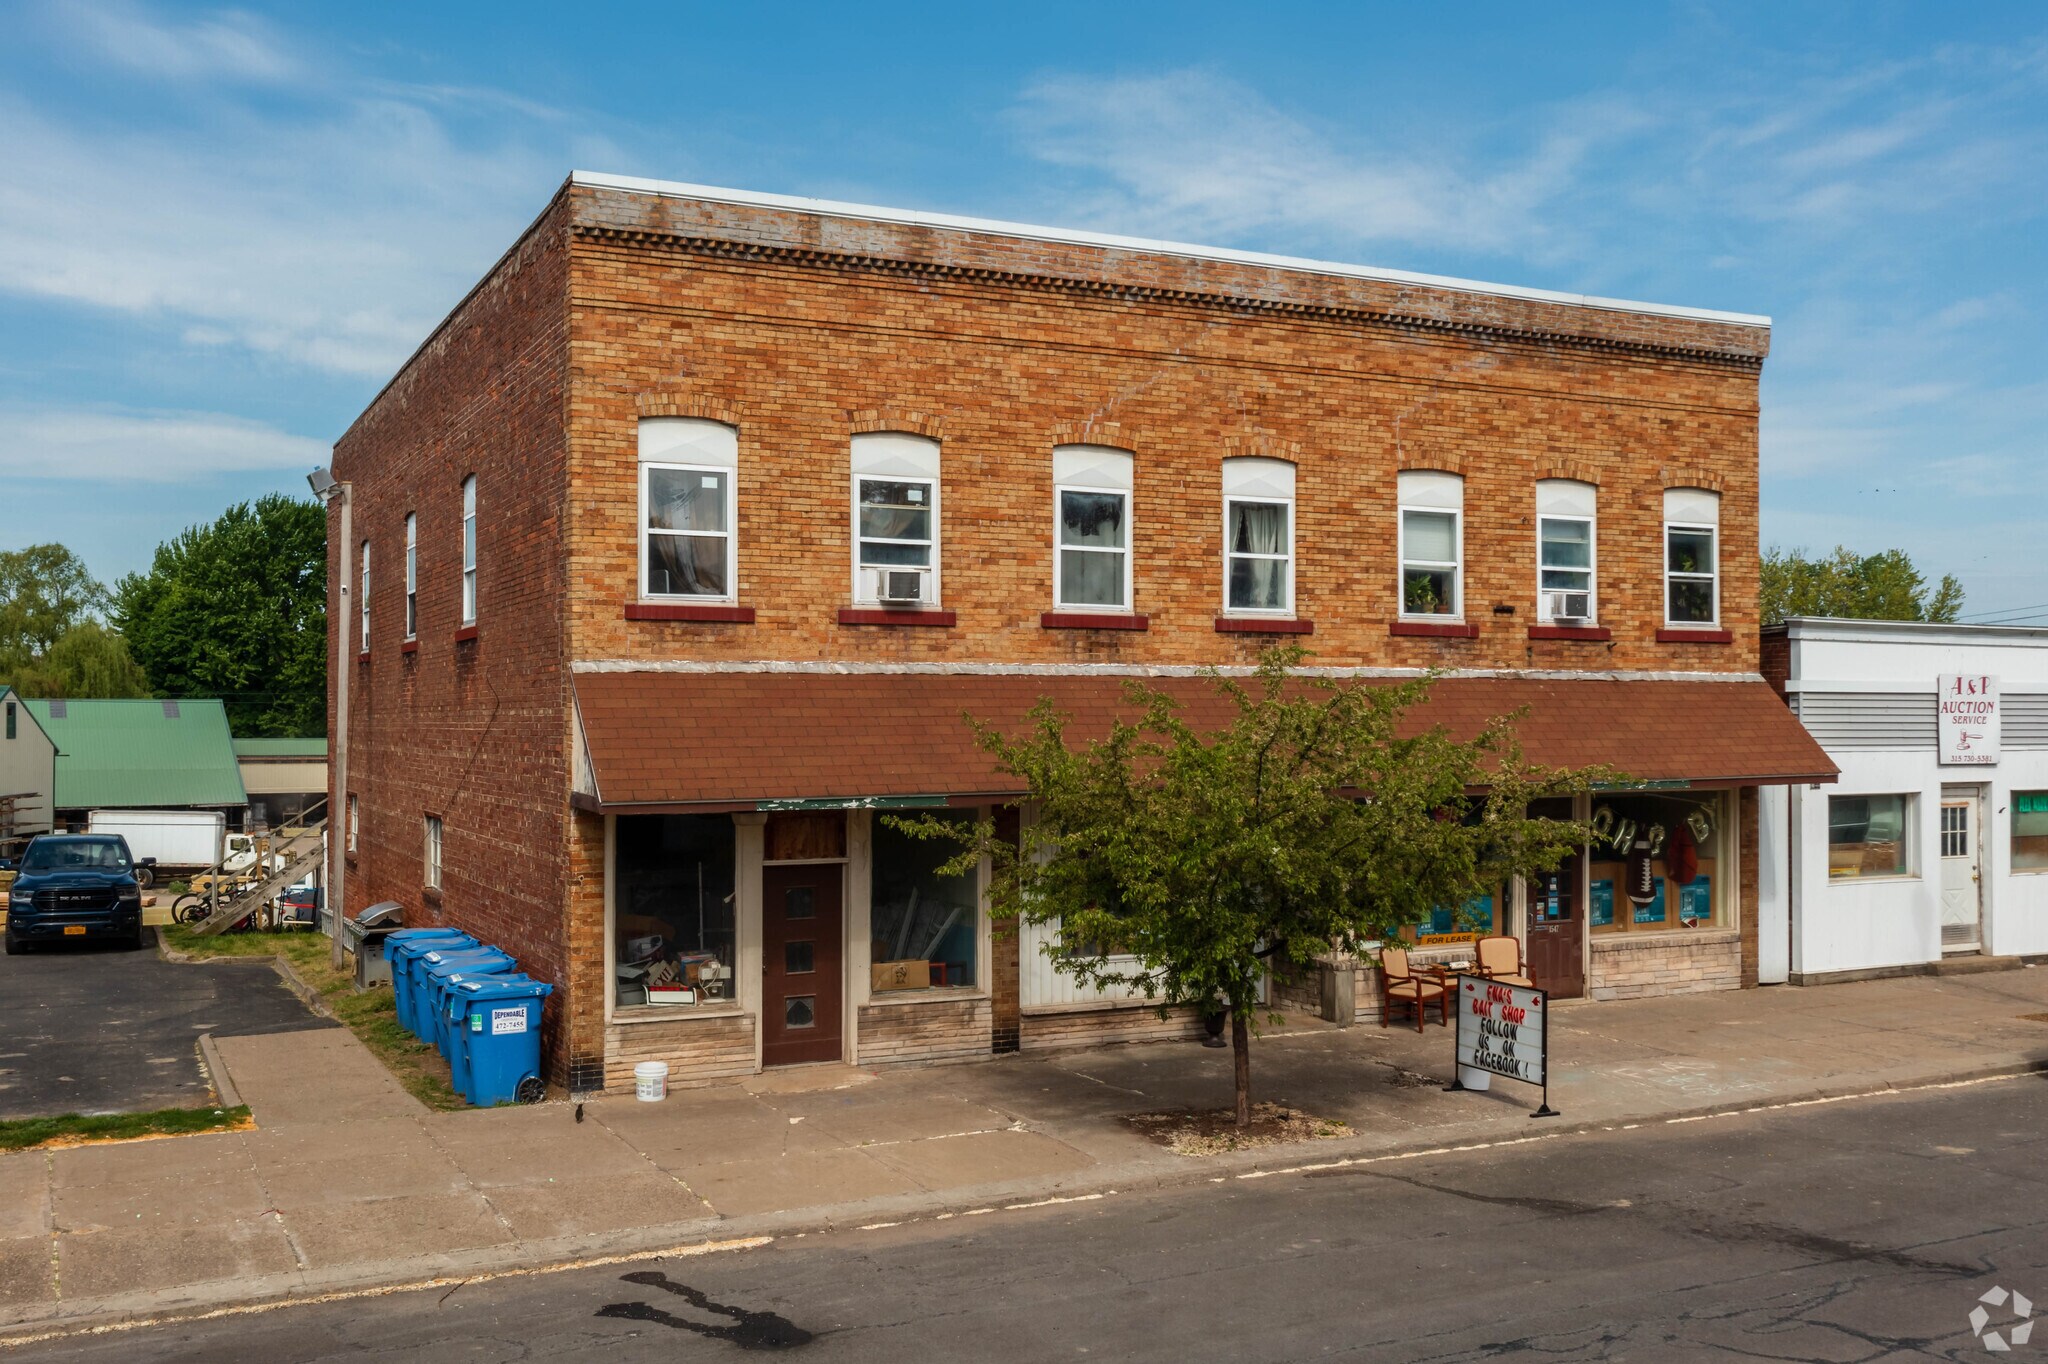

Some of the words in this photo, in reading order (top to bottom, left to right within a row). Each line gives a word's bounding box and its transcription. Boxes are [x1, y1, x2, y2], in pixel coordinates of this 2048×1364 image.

[1950, 677, 1962, 698] A
[1967, 679, 1976, 695] &
[1979, 676, 1990, 695] P
[1941, 701, 1994, 713] AUCTION
[1952, 716, 1987, 724] SERVICE
[1426, 936, 1444, 944] FOR
[1446, 935, 1472, 943] LEASE
[495, 1009, 524, 1019] DEPENDABLE
[1472, 998, 1493, 1017] BAIT
[1502, 1005, 1526, 1024] SHOP
[1481, 1018, 1518, 1041] FOLLOW
[1478, 1034, 1489, 1051] US
[1502, 1040, 1515, 1057] ON
[1474, 1050, 1521, 1076] FACEBOOK
